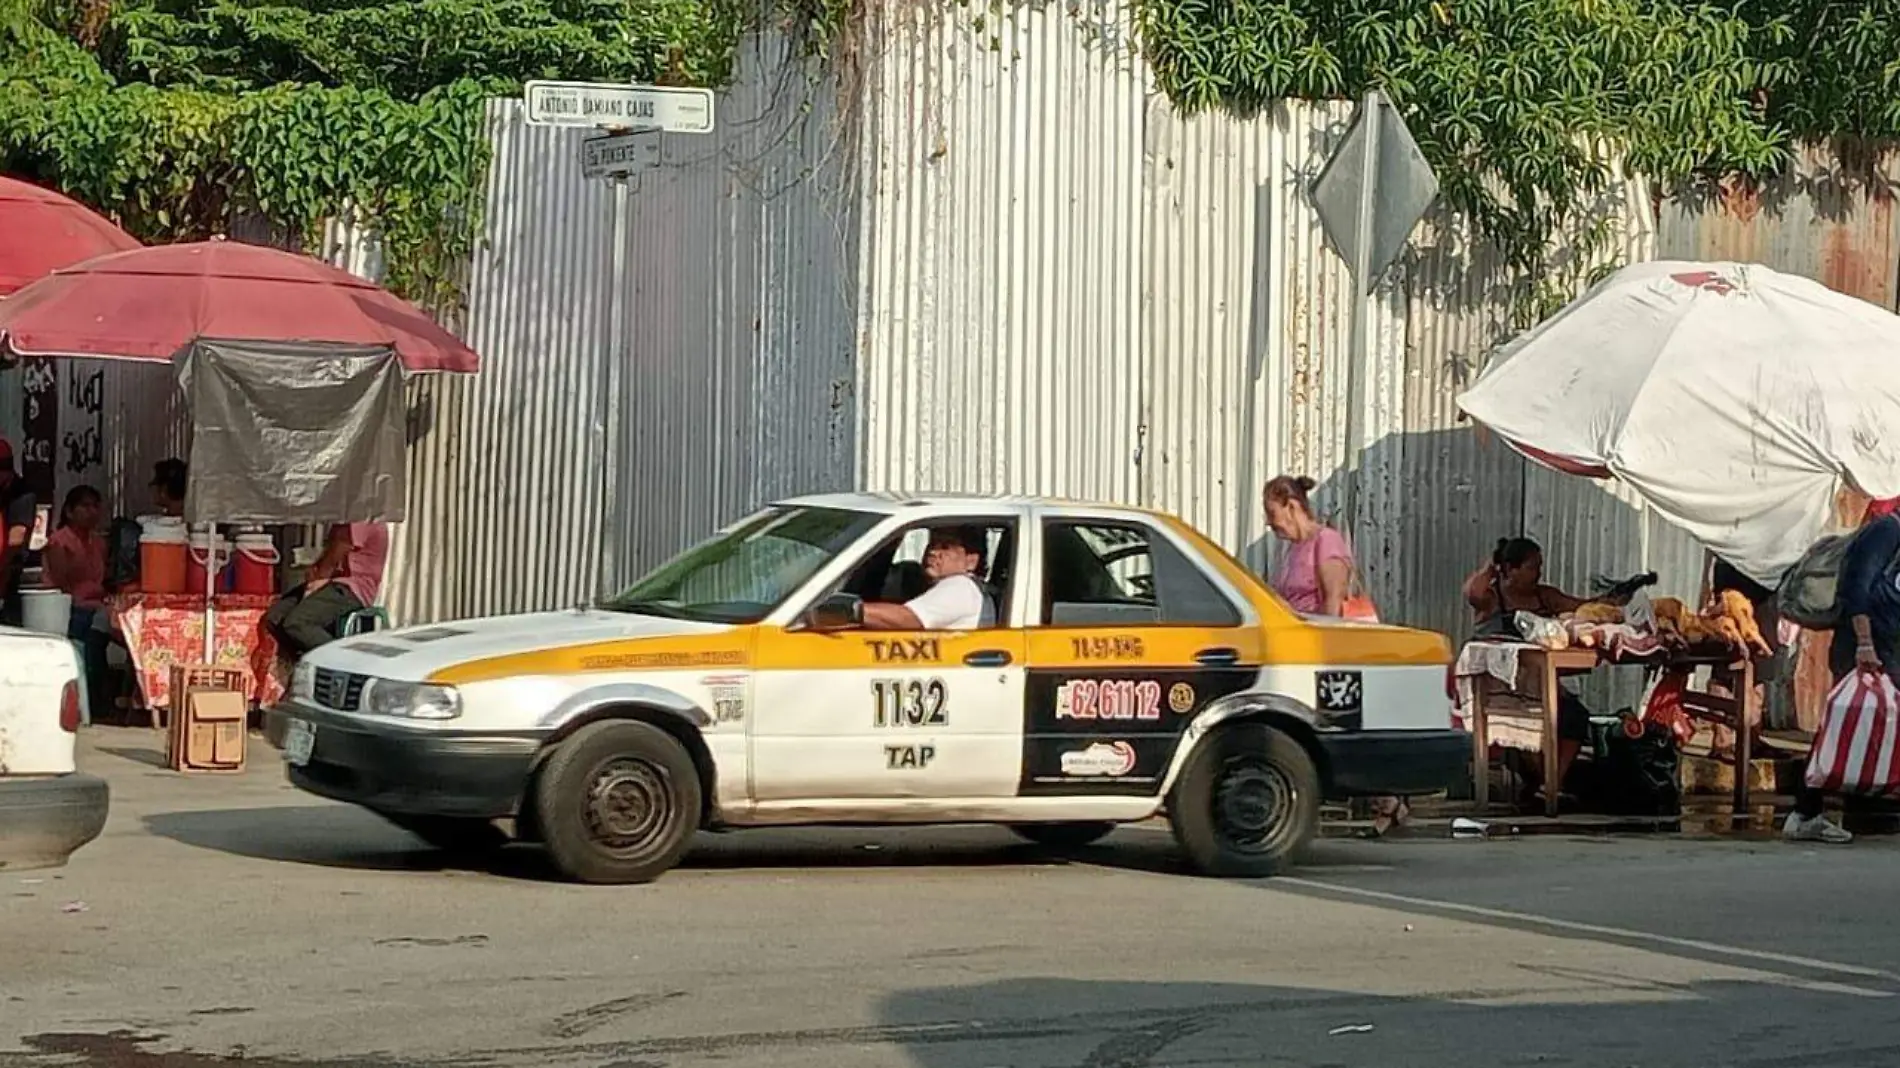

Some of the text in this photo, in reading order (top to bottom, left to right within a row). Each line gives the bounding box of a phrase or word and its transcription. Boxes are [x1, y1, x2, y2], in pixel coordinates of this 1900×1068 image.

[539, 97, 577, 113] ANTONIO
[864, 638, 941, 661] TAXI
[871, 678, 949, 727] 1132
[884, 744, 936, 769] TAP
